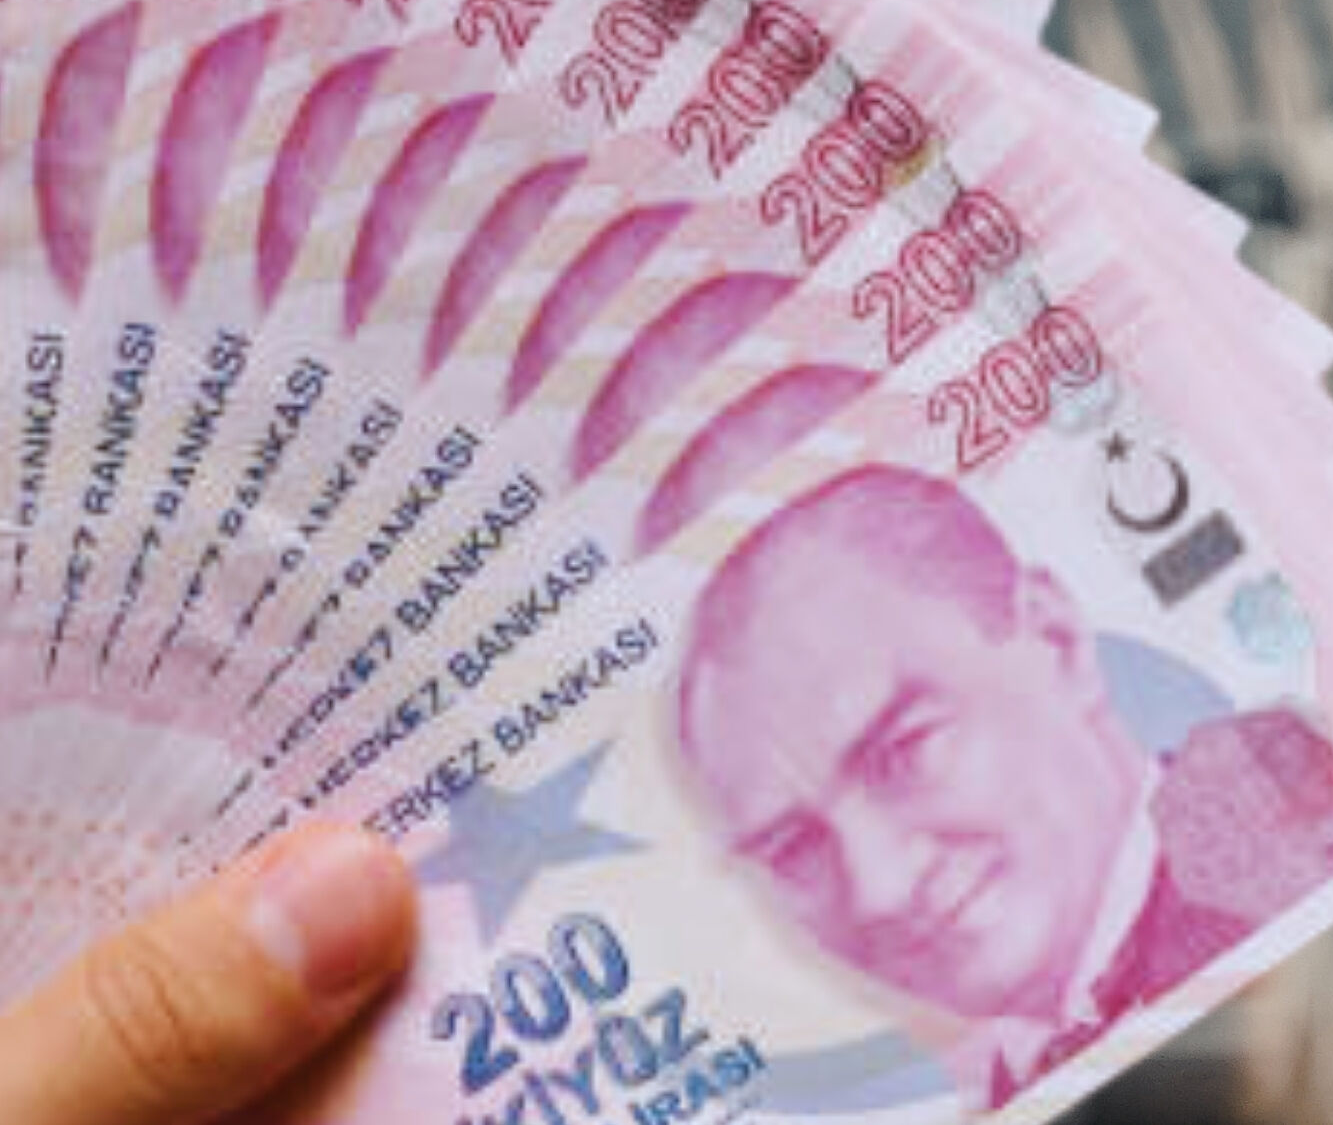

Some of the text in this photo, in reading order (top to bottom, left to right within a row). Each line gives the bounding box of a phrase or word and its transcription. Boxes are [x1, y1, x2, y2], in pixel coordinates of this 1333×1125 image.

[760, 79, 928, 267] 200
[852, 188, 1024, 364] 200
[929, 304, 1103, 473] 200
[395, 473, 544, 635] BANKASI
[447, 539, 608, 690] BANKASI
[493, 617, 660, 756] BANKASI
[430, 911, 631, 1096] 200
